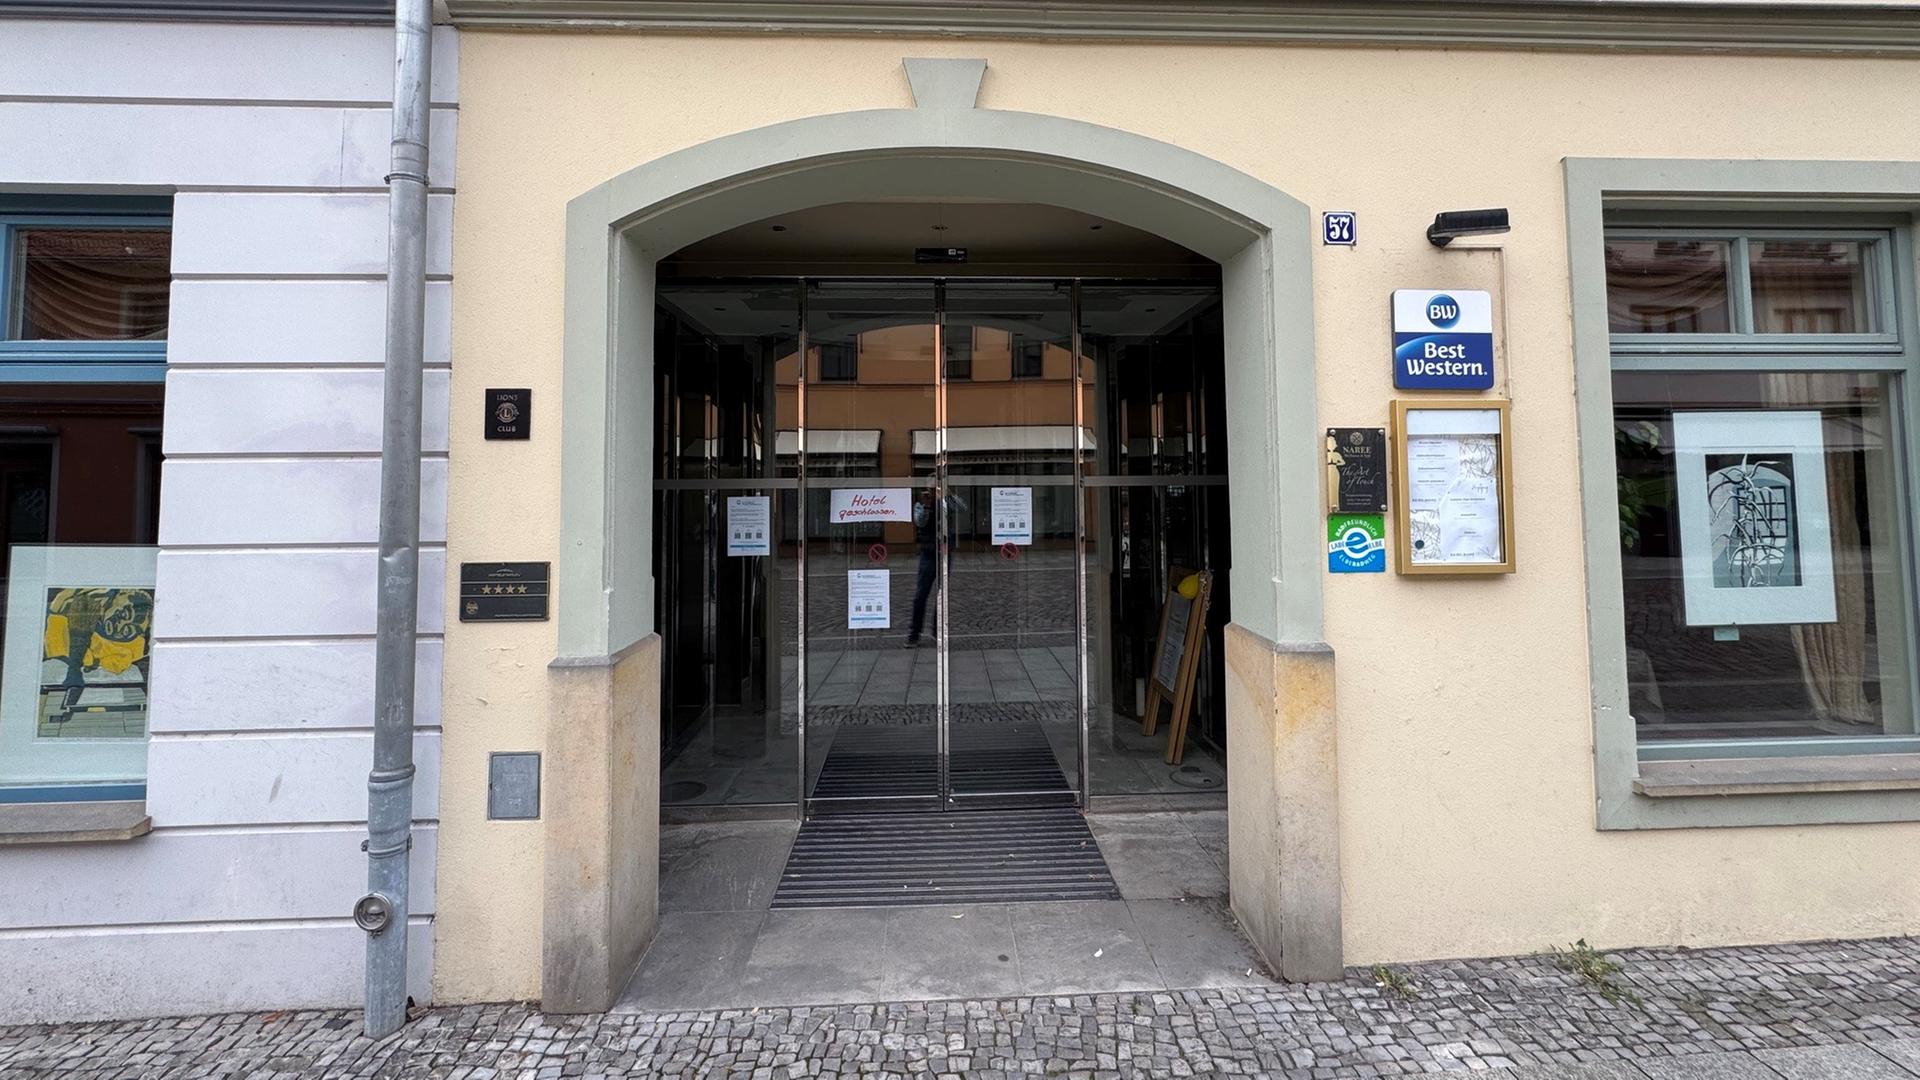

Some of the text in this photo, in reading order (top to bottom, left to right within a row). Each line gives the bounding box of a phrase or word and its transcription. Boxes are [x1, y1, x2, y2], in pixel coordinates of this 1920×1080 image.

[1329, 216, 1350, 240] 57
[1430, 305, 1457, 320] BW
[1424, 342, 1466, 359] Best
[497, 425, 516, 433] CLUB
[1342, 446, 1372, 454] NAREE
[851, 494, 887, 507] Hotel
